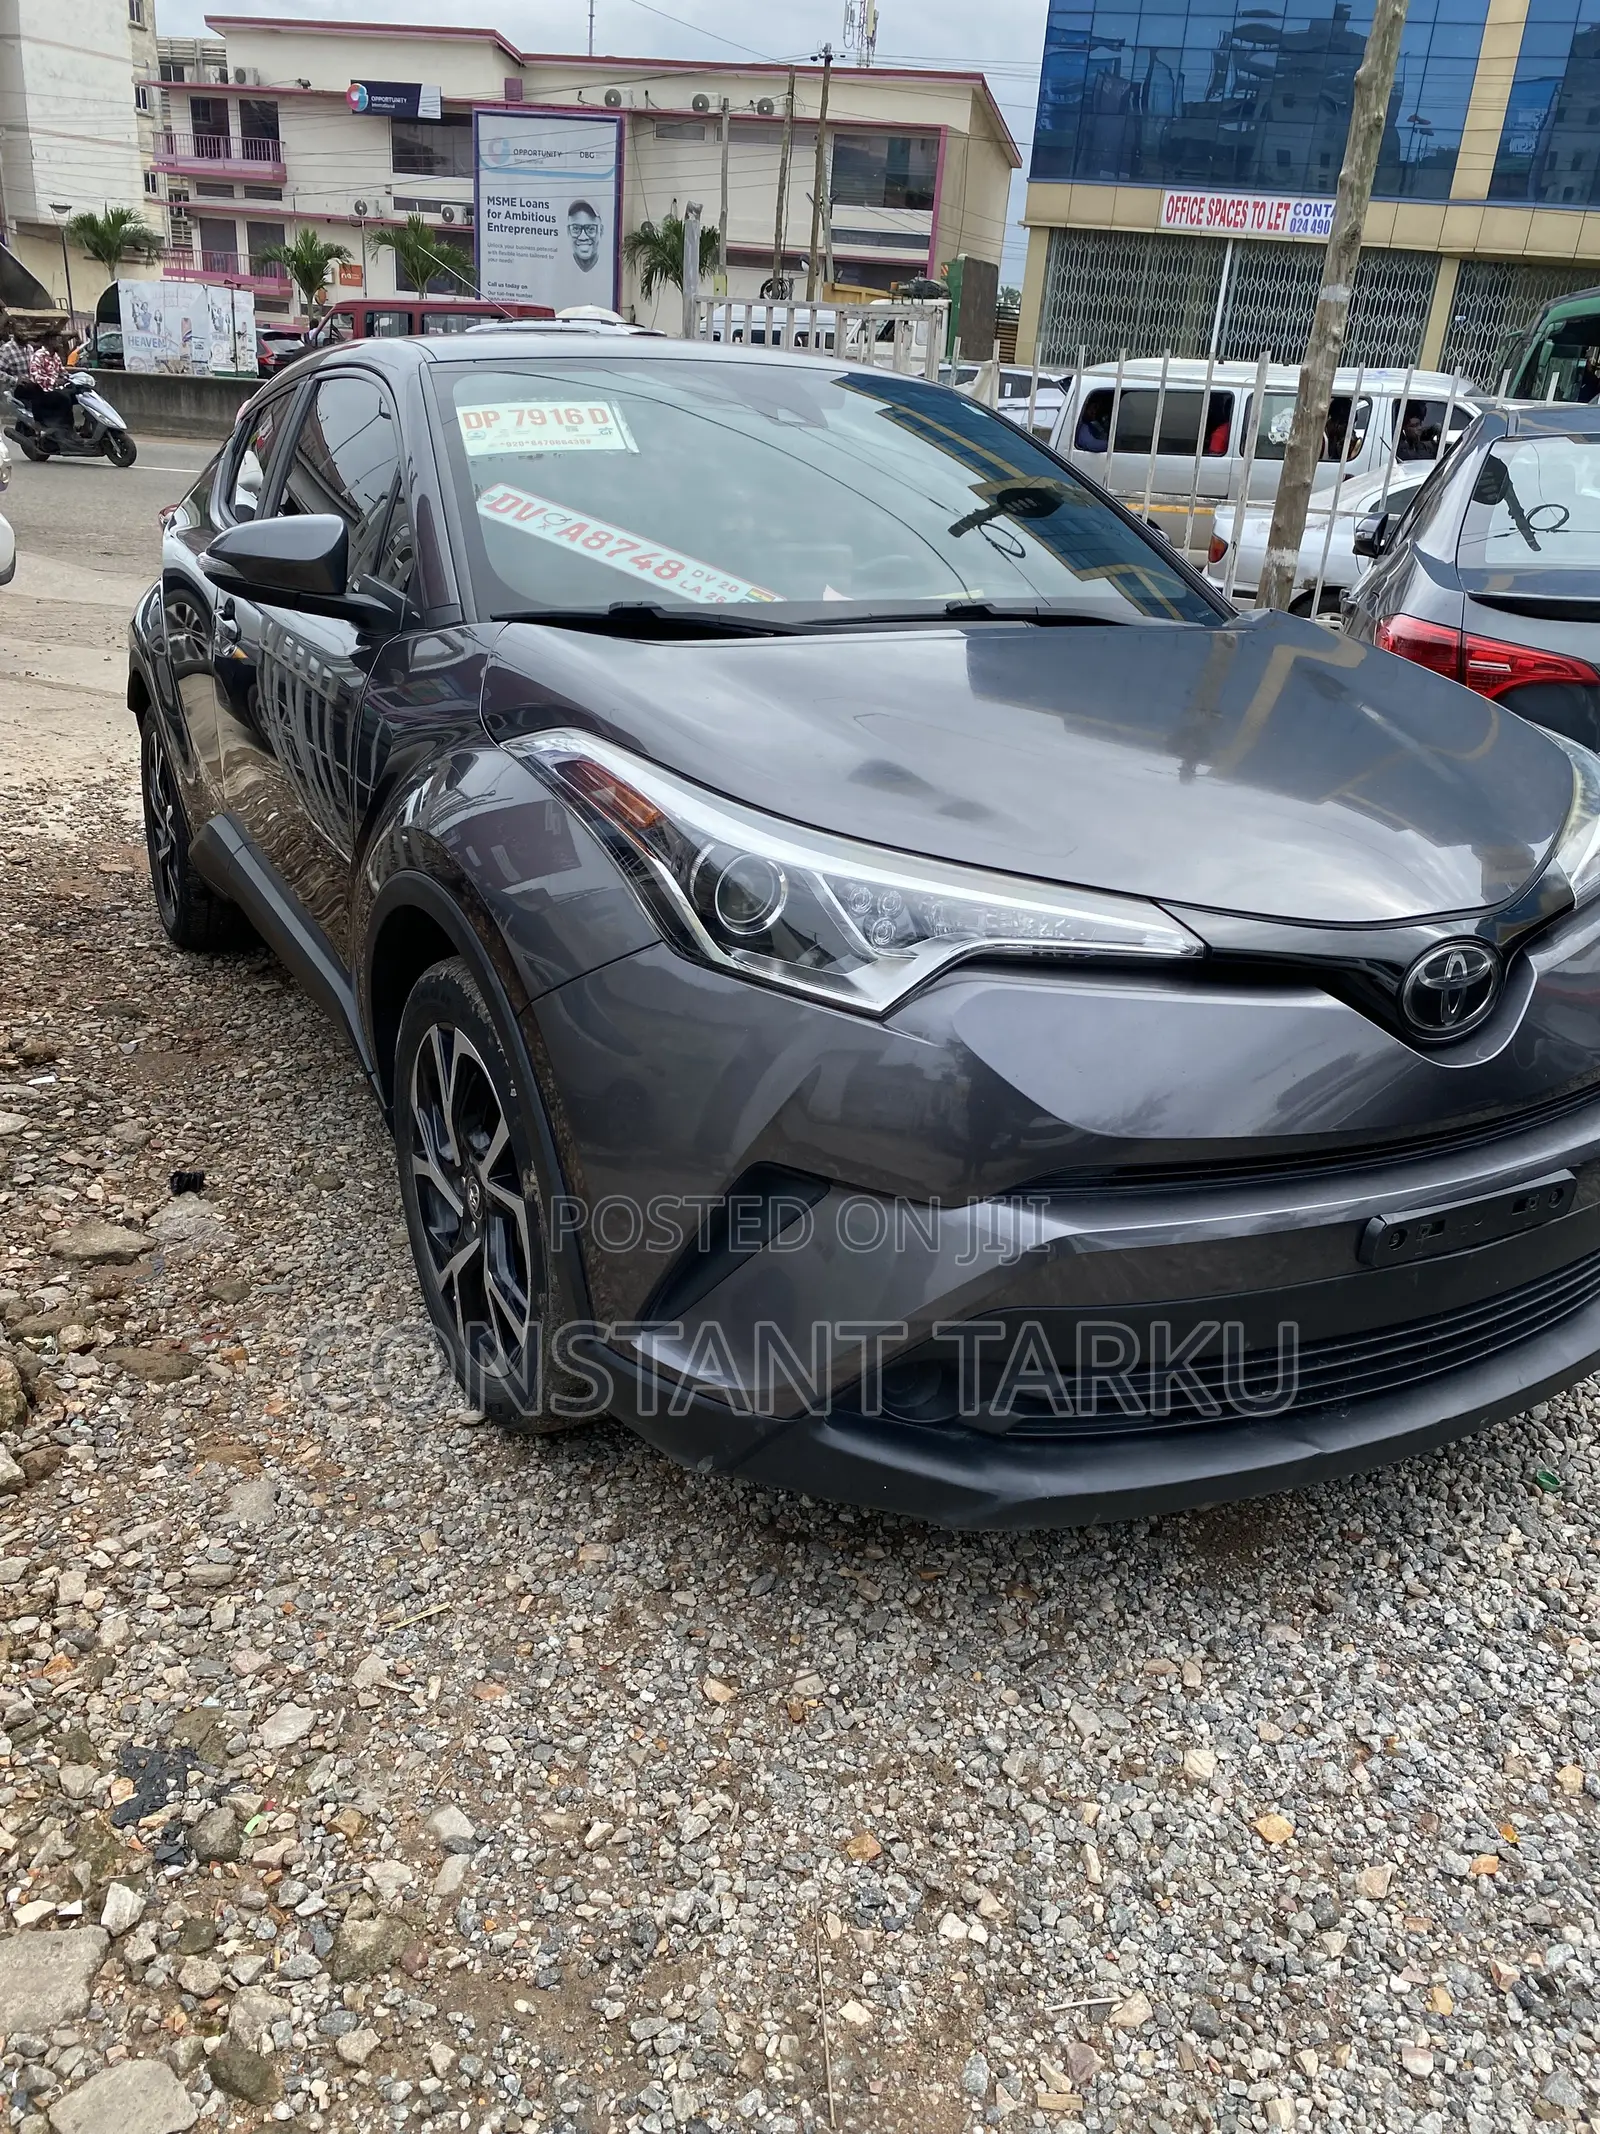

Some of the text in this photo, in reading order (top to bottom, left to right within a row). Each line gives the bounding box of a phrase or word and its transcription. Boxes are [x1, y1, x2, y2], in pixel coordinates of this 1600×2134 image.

[513, 149, 561, 158] OPPORTUNITY
[487, 196, 550, 209] MSME Loans
[487, 209, 557, 223] for Ambitious
[1166, 195, 1291, 231] OFFICE SPACES TO LET
[487, 222, 559, 236] Entrepreneurs
[1290, 218, 1330, 234] 024 490
[128, 336, 165, 348] HEAVEN
[462, 408, 610, 430] DP 7916 D
[484, 493, 685, 580] DV A8748
[679, 580, 702, 595] LA
[692, 569, 740, 593] DV 20
